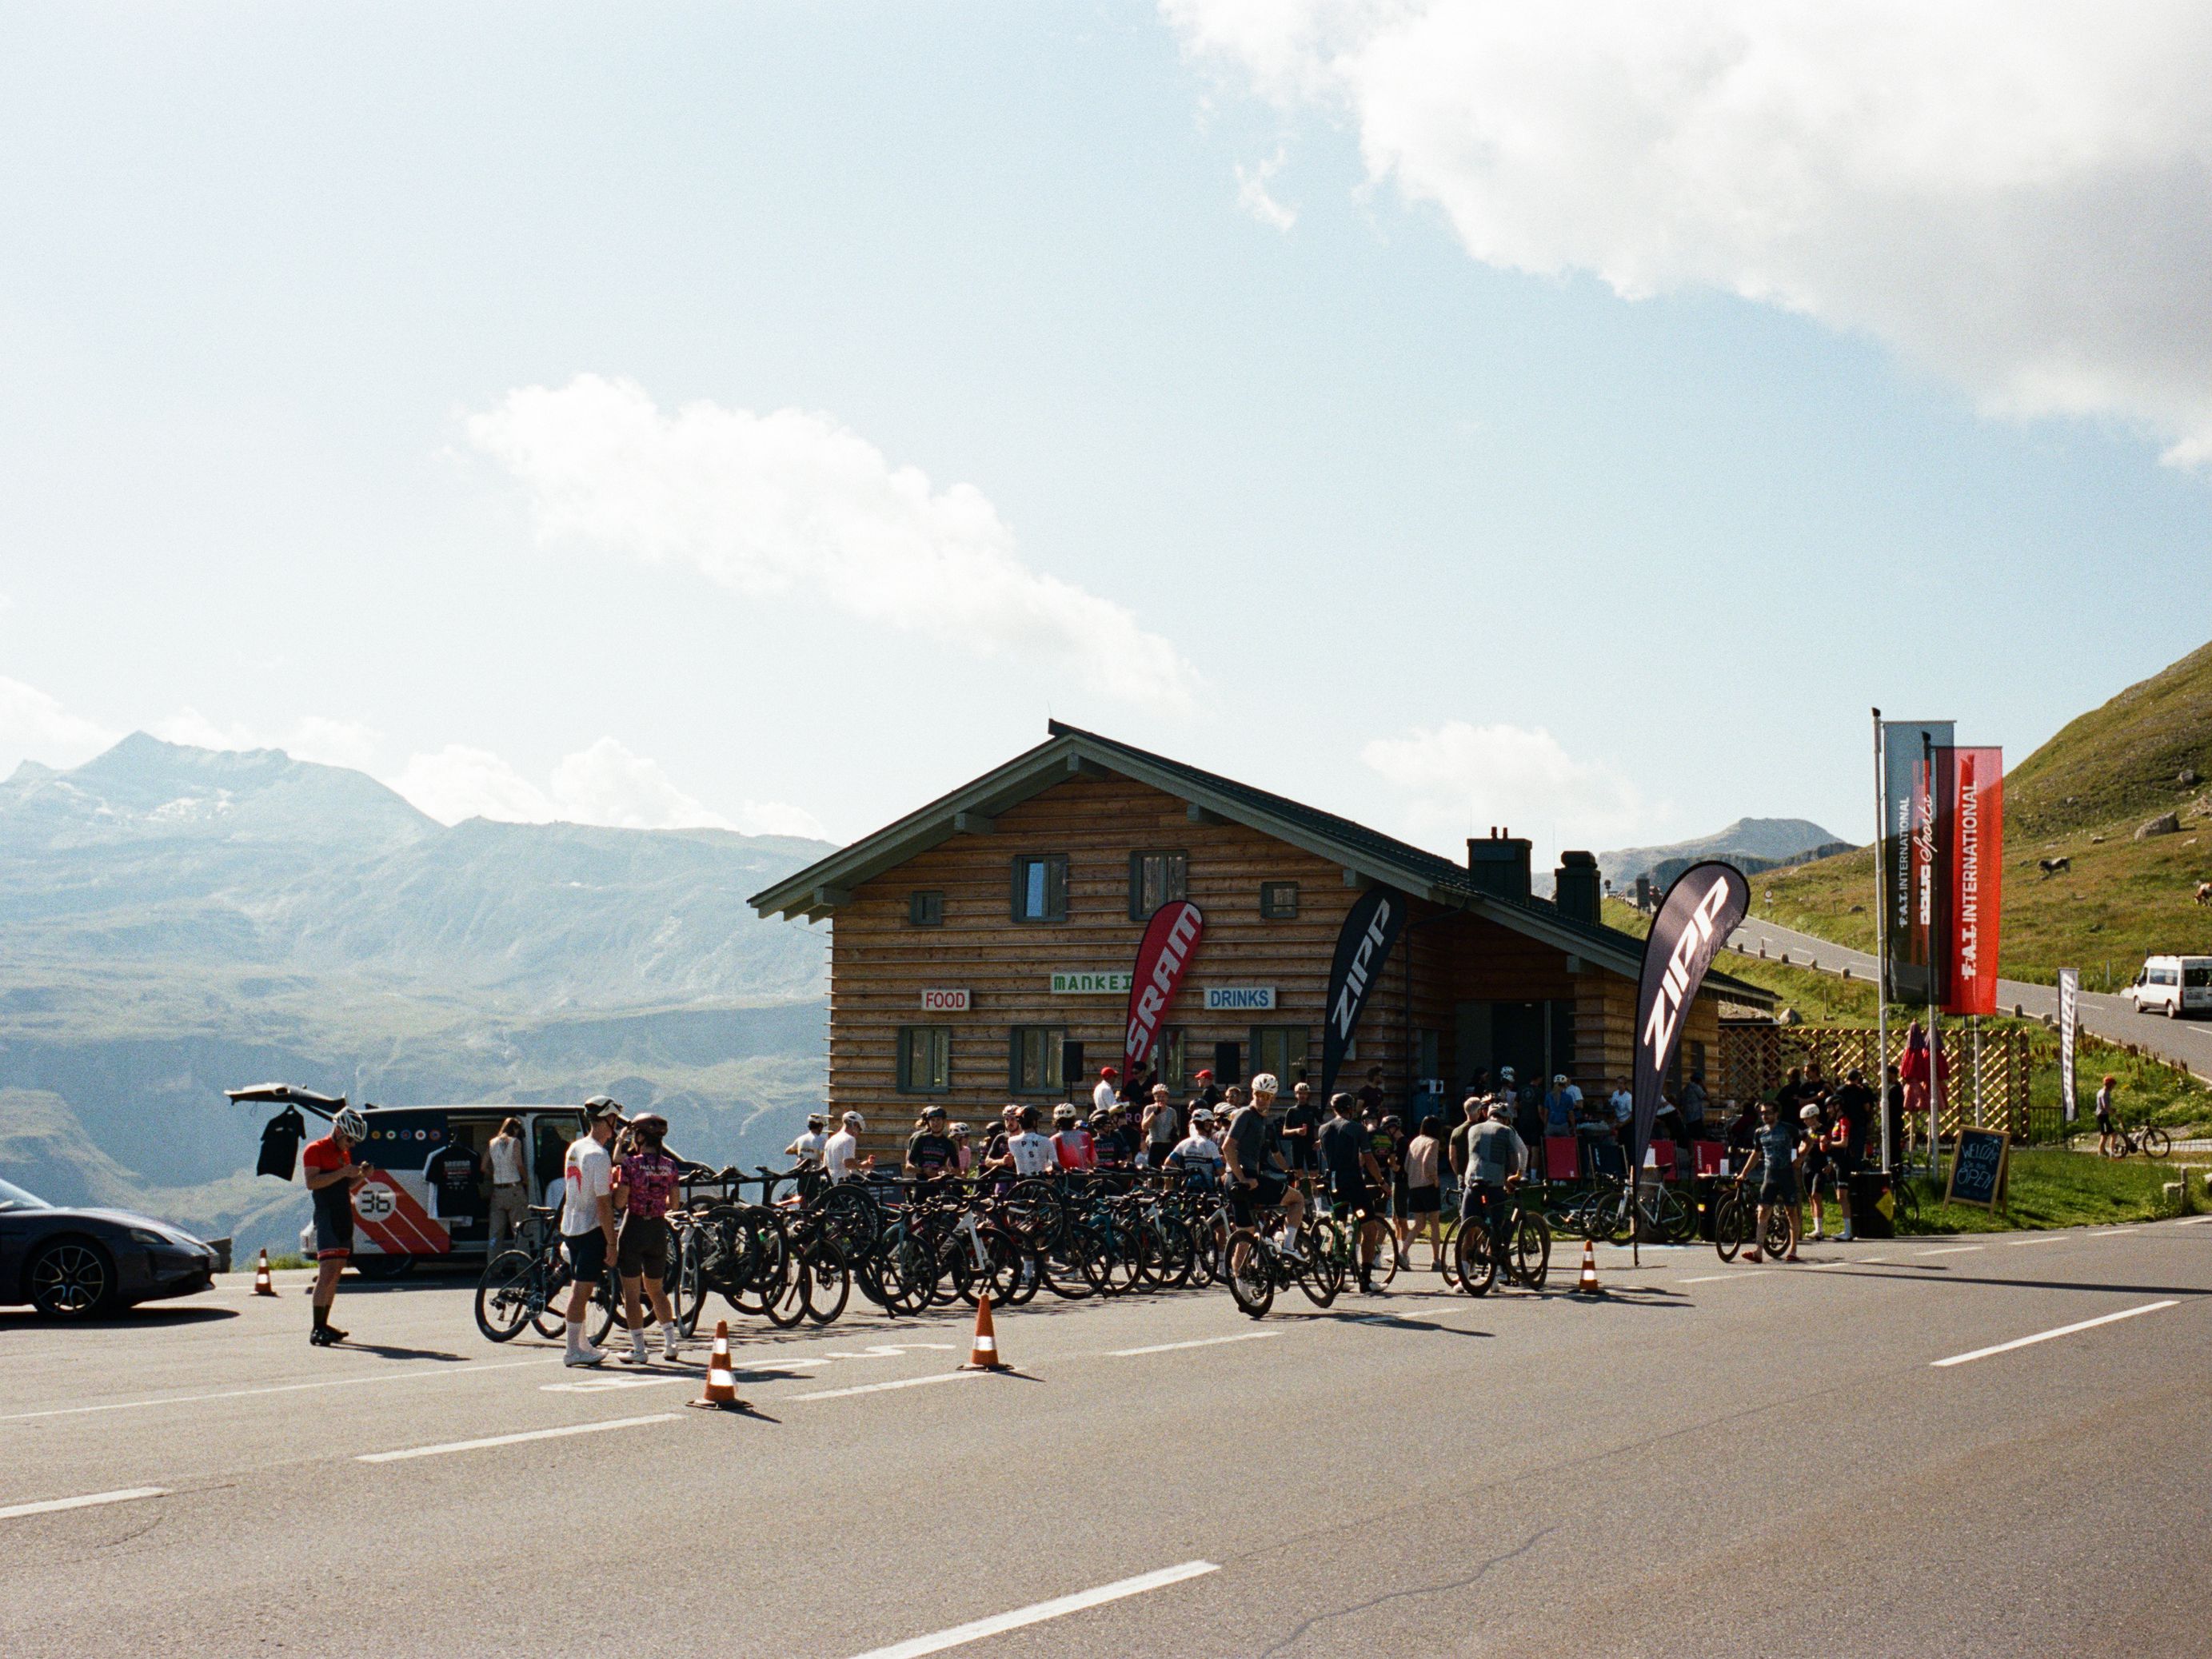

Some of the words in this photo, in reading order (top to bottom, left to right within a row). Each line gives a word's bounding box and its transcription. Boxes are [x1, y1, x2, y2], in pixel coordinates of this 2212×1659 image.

[1899, 796, 1910, 890] INTERNATIONAL
[1962, 780, 1978, 922] INTERNATIONAL
[925, 991, 966, 1008] FOOD
[1126, 903, 1203, 1062] SRAM
[1210, 989, 1269, 1007] DRINKS
[1332, 898, 1391, 1040] ZIPP
[1643, 875, 1730, 1071] ZIPP
[1957, 1167, 1996, 1190] OPEN
